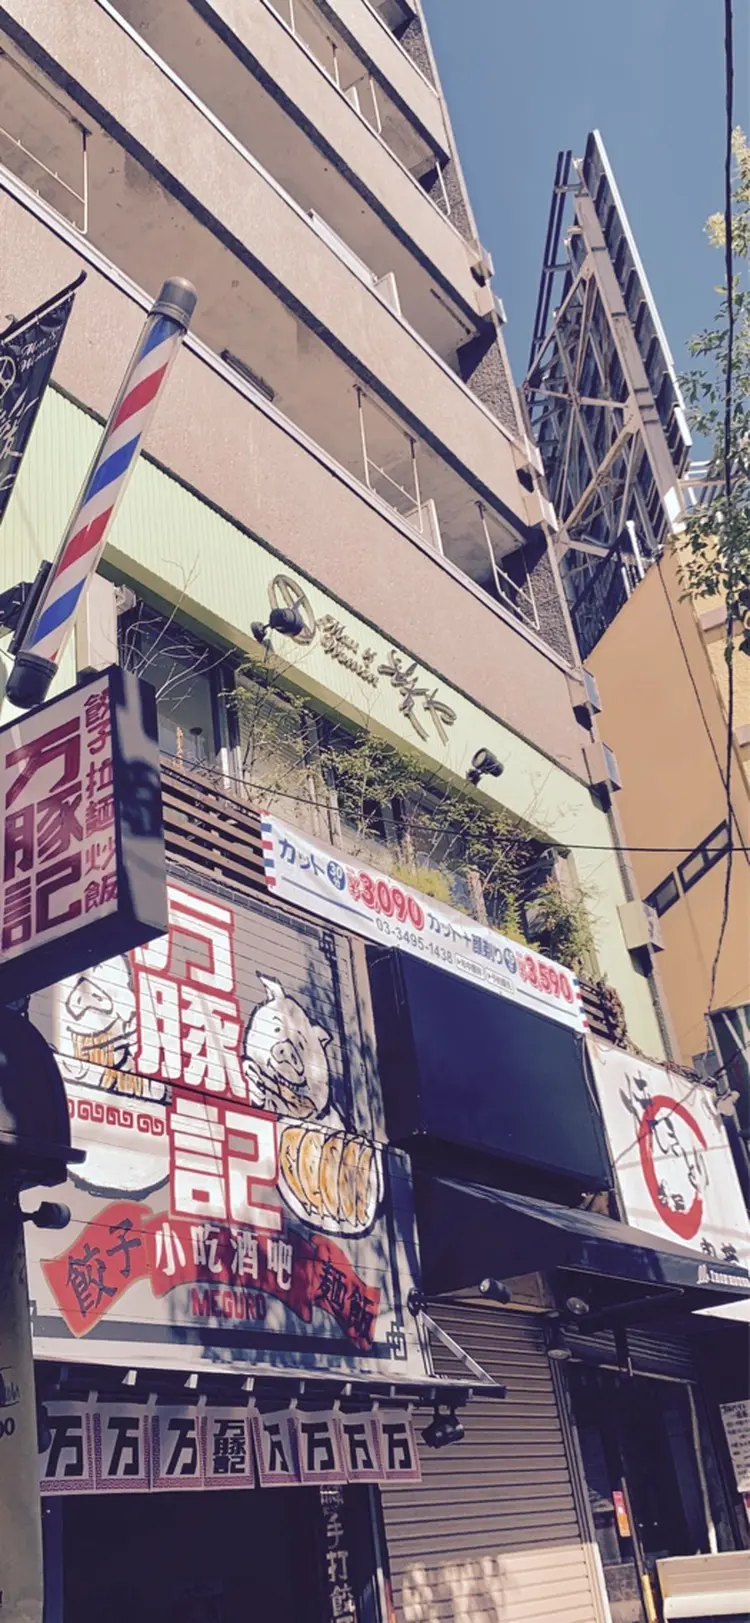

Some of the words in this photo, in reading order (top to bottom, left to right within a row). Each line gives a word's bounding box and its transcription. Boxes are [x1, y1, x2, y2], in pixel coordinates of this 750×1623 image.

[1, 716, 83, 950] 万豚記
[279, 838, 325, 877] カット
[375, 917, 454, 965] 03-3495-1438
[132, 884, 285, 1232] 万豚記
[66, 1218, 142, 1317] 餃子
[155, 1222, 293, 1291] 小吃酒吧
[189, 1287, 267, 1321] MEGURO
[107, 1416, 140, 1476] 万
[165, 1417, 197, 1476] 万
[213, 1418, 246, 1474] 万豚記
[301, 1421, 336, 1471] 万
[343, 1423, 374, 1470] 万
[382, 1423, 412, 1470] 万
